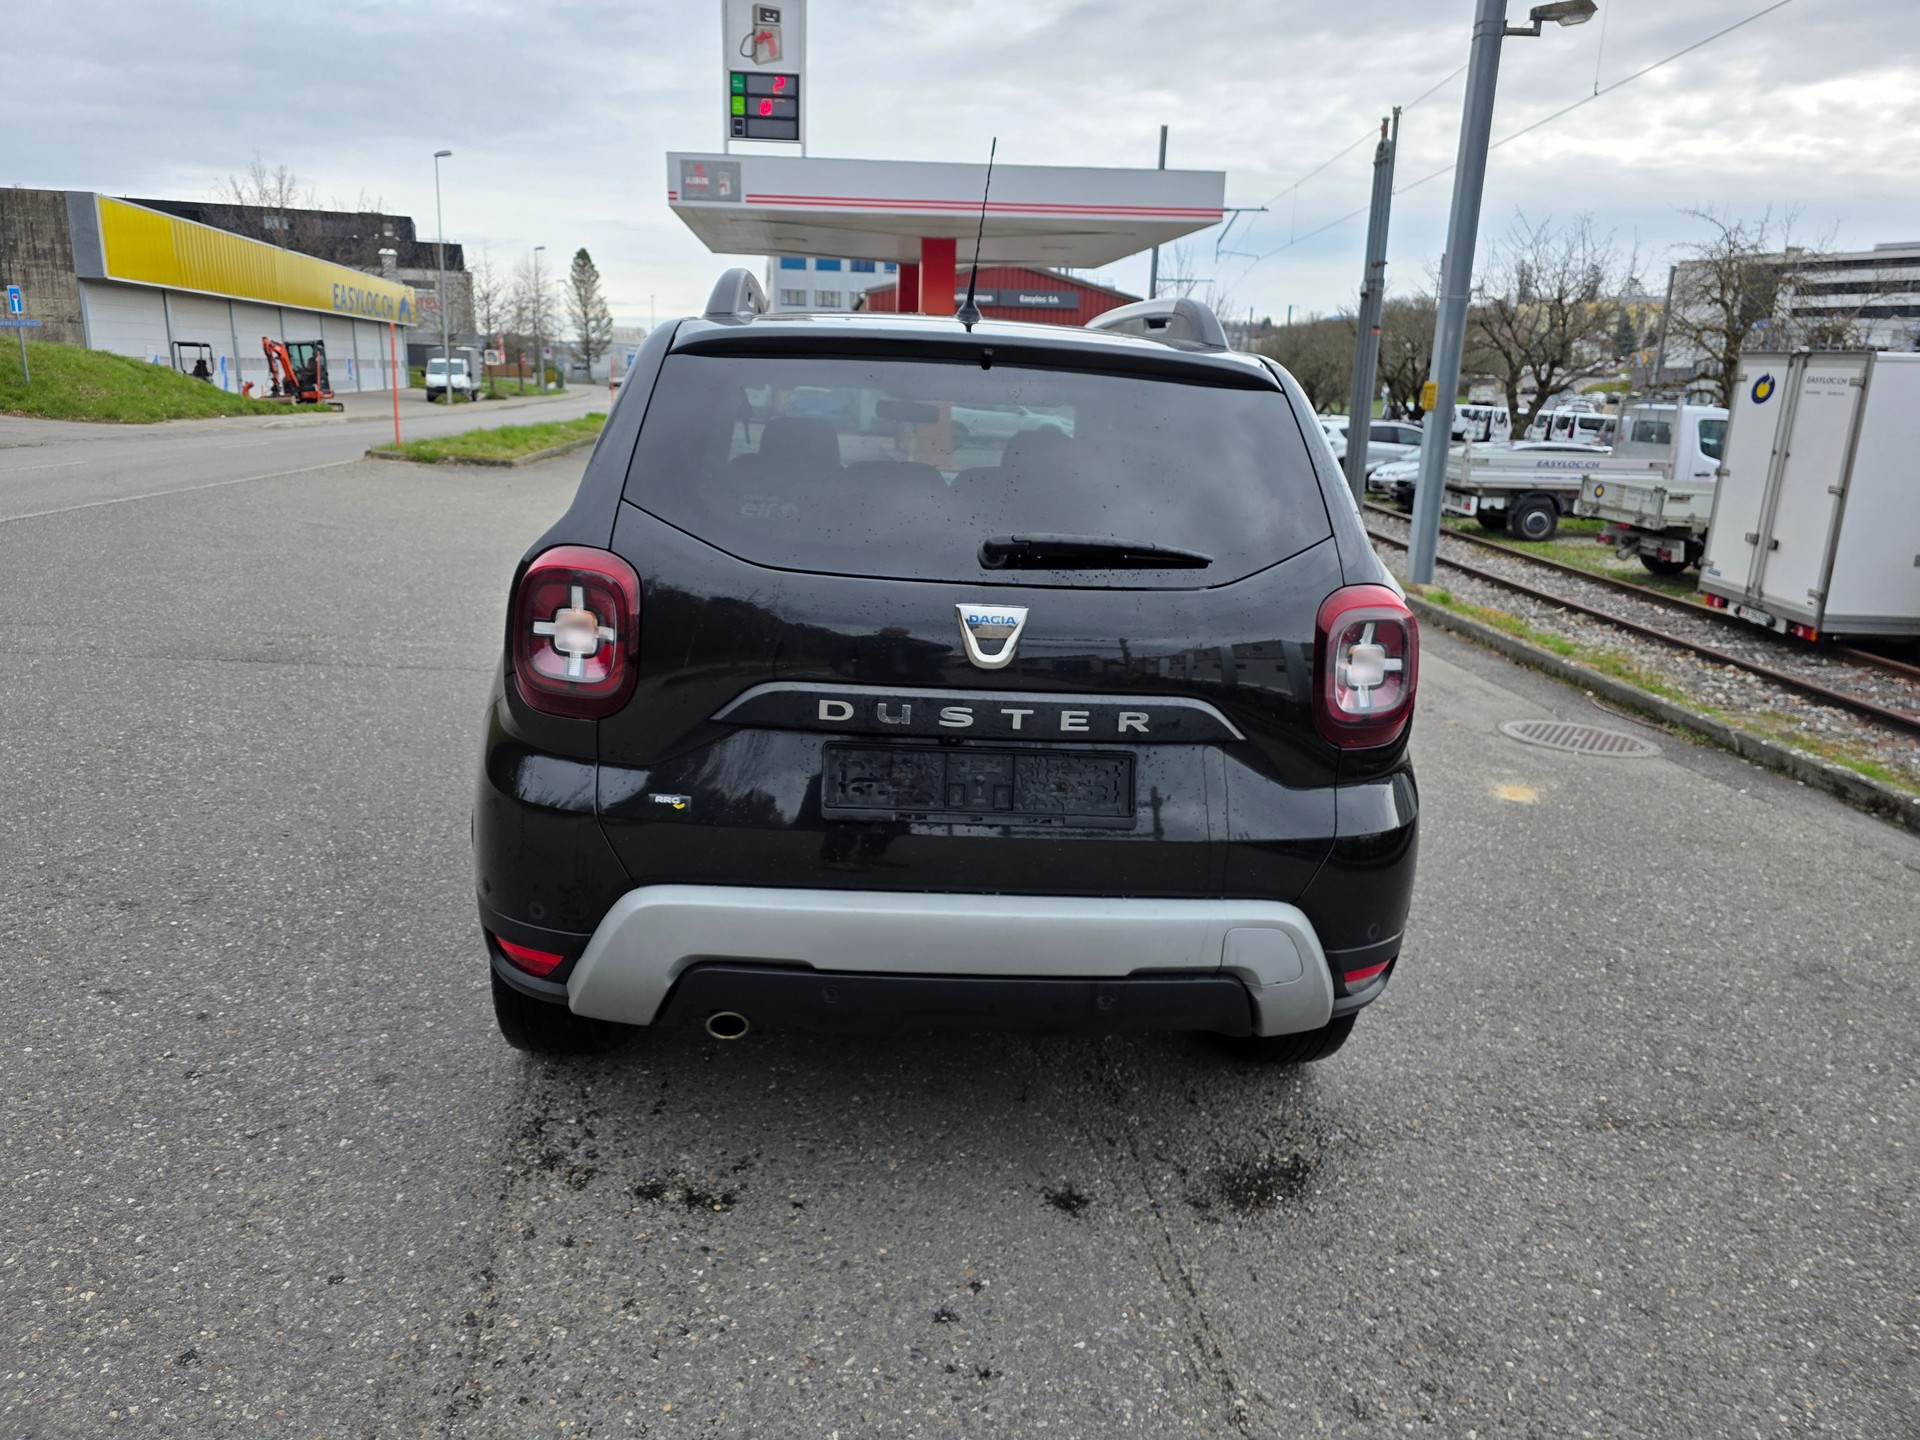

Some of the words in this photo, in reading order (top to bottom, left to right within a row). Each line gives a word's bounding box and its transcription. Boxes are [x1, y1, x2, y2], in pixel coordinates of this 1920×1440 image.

[968, 614, 1017, 626] DACIA
[818, 699, 1150, 733] DUSTER
[654, 795, 681, 804] RRG
